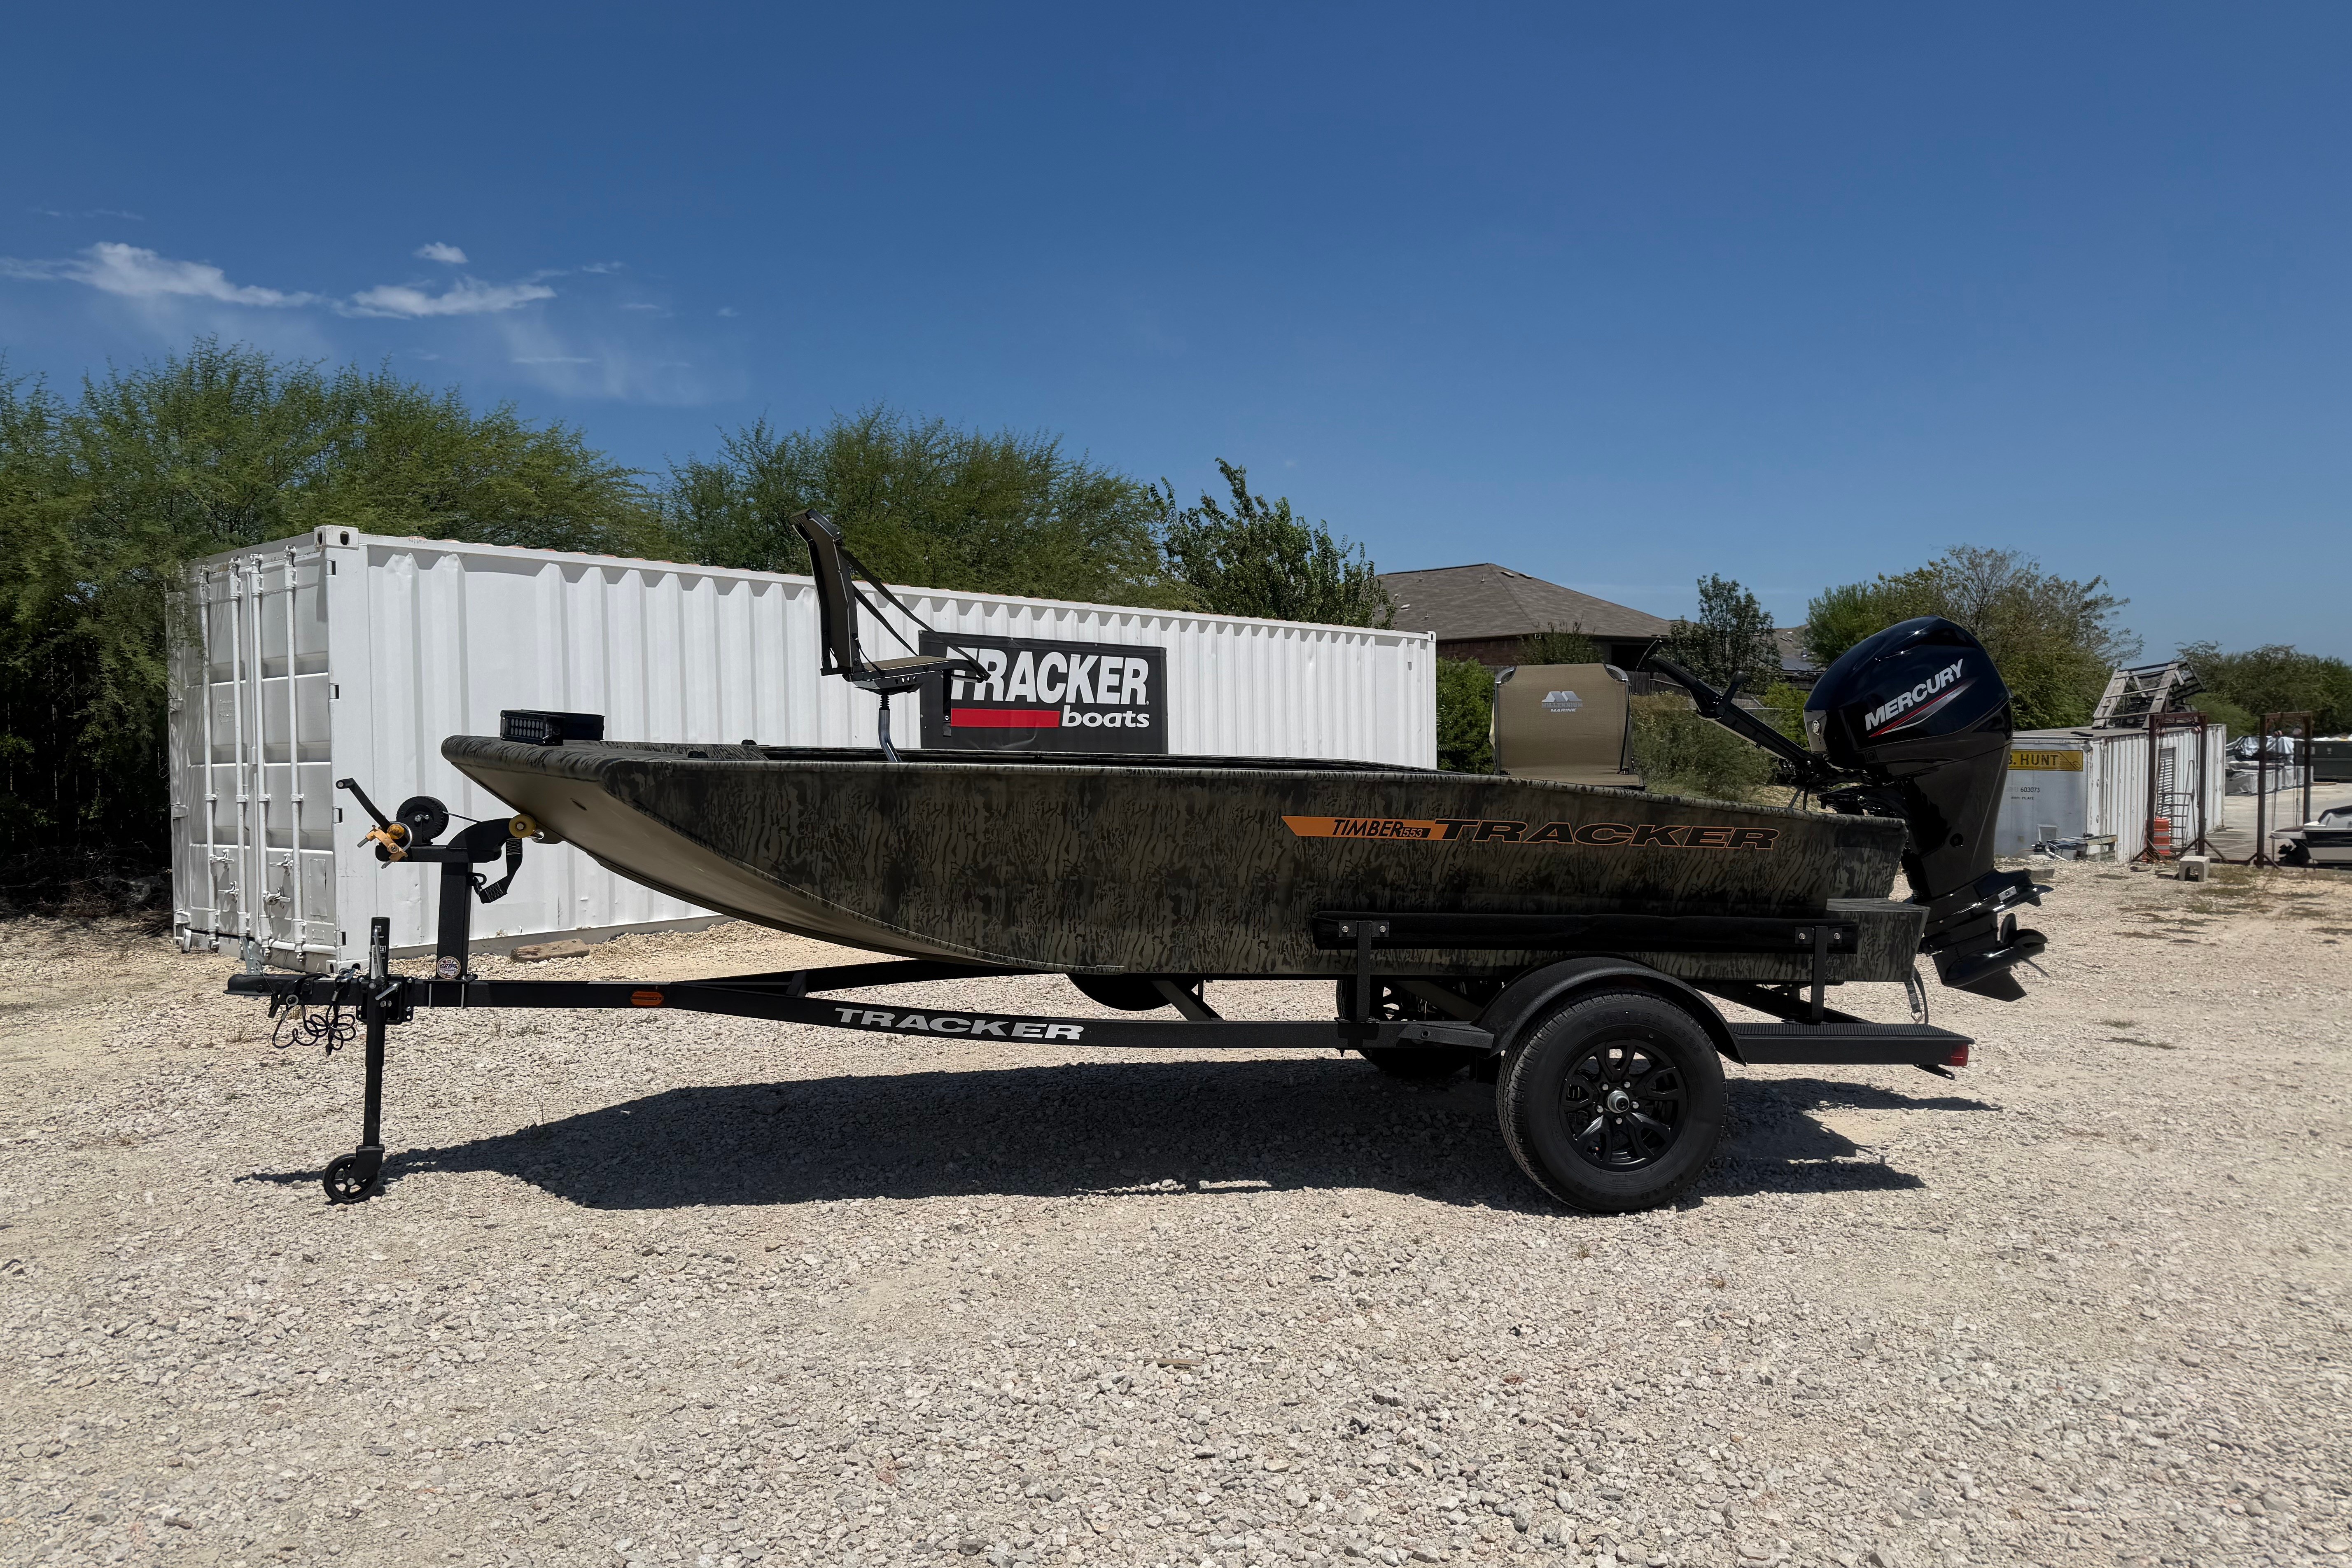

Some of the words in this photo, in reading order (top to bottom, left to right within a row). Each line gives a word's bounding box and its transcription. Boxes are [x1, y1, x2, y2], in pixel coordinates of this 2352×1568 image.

[946, 646, 1149, 705] TRACKER
[1865, 658, 1963, 731] MERCURY
[1062, 705, 1150, 728] boats
[2021, 754, 2058, 766] HUNT
[1332, 819, 1404, 837] TIMBER
[1400, 828, 1423, 838] 1553
[1435, 818, 1780, 850] TRACKER
[835, 1008, 1084, 1040] TRACKER
